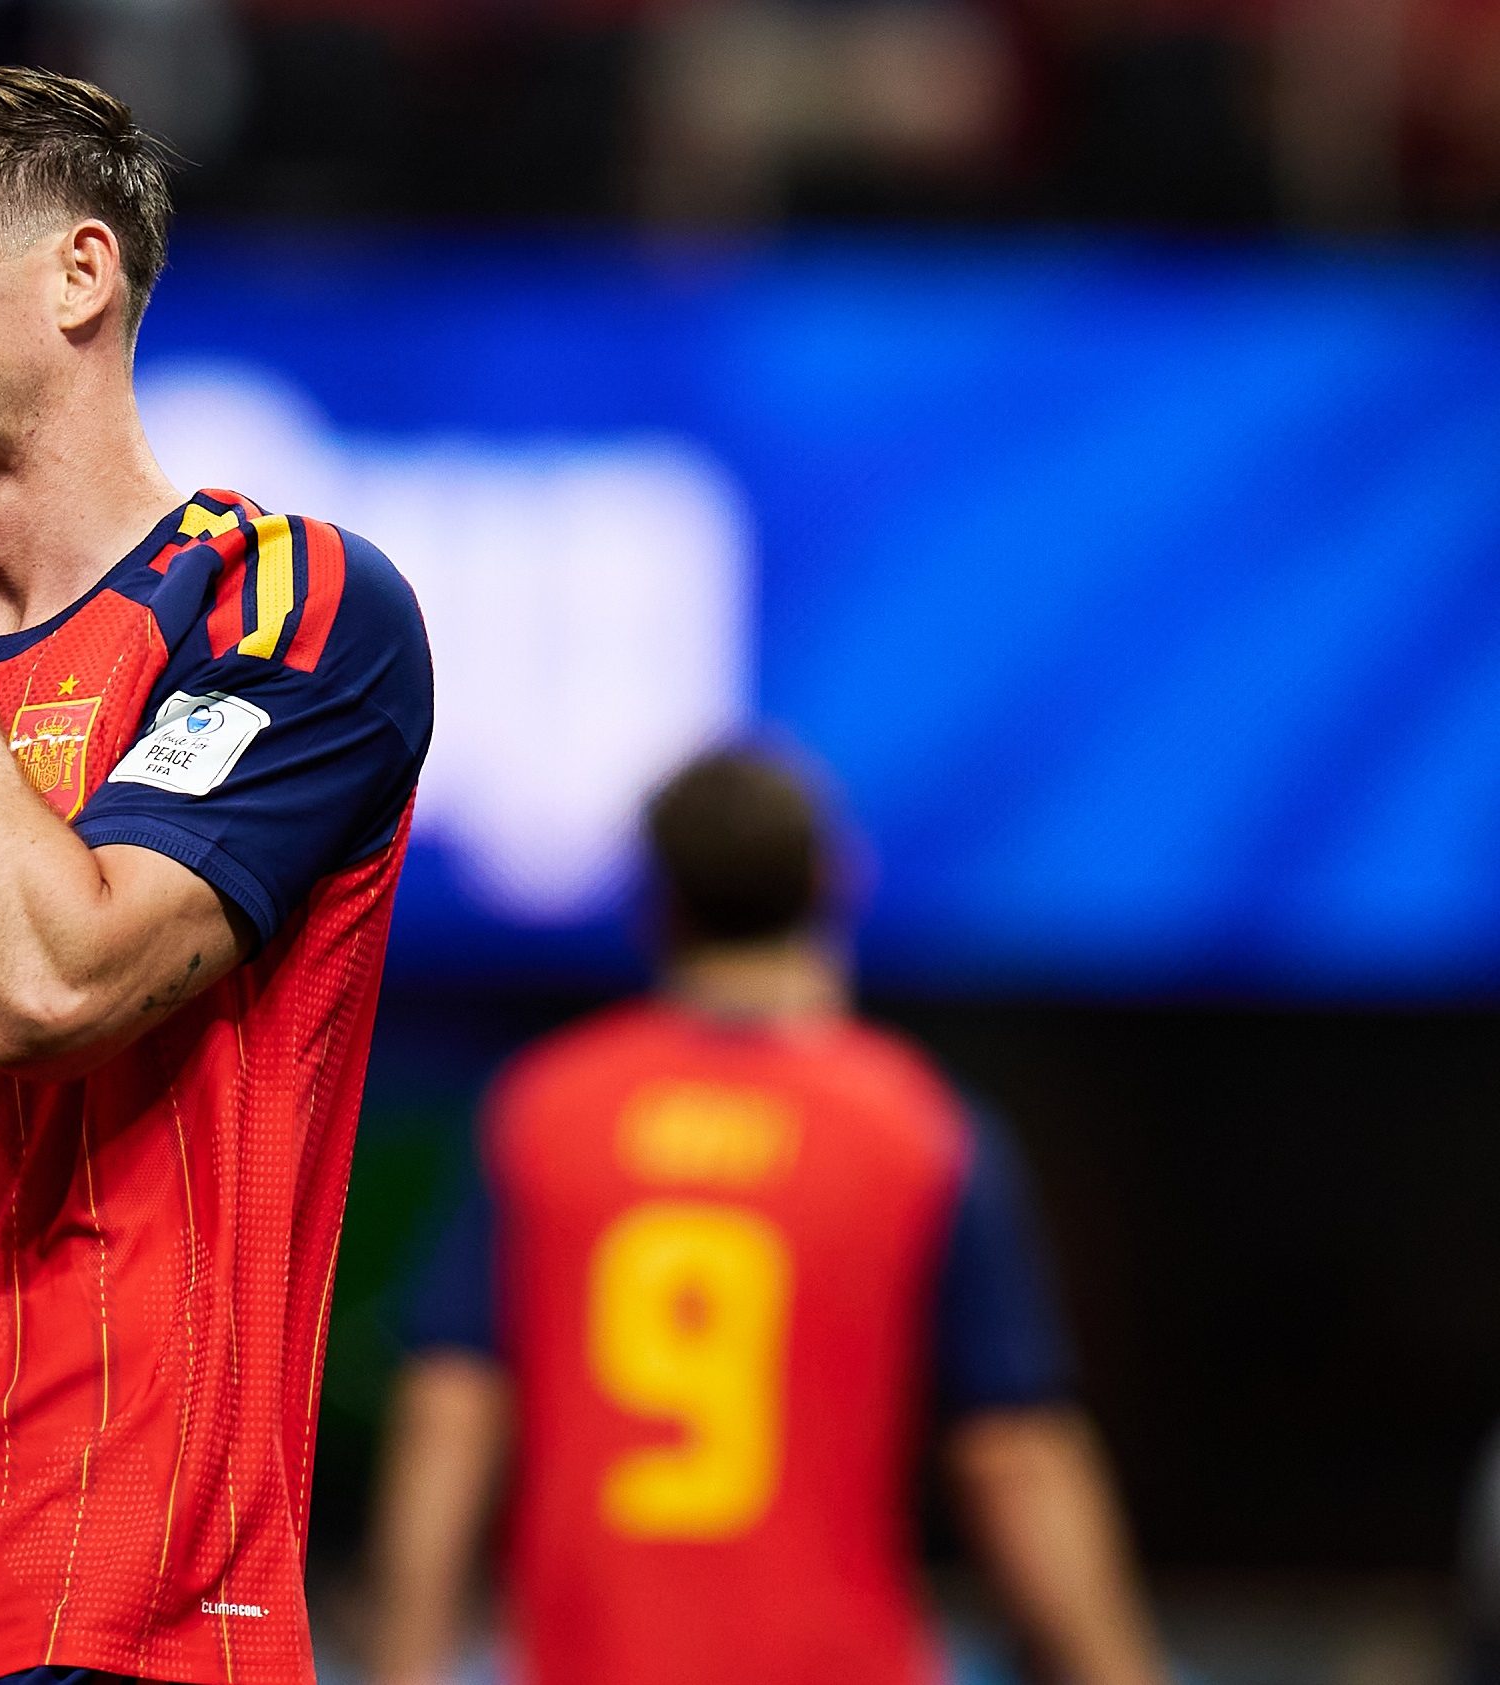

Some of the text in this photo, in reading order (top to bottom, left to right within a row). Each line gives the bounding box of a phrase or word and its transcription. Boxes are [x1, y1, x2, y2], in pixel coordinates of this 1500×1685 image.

[145, 744, 197, 770] PEACE
[146, 763, 171, 776] FIFA
[590, 1202, 789, 1541] 9
